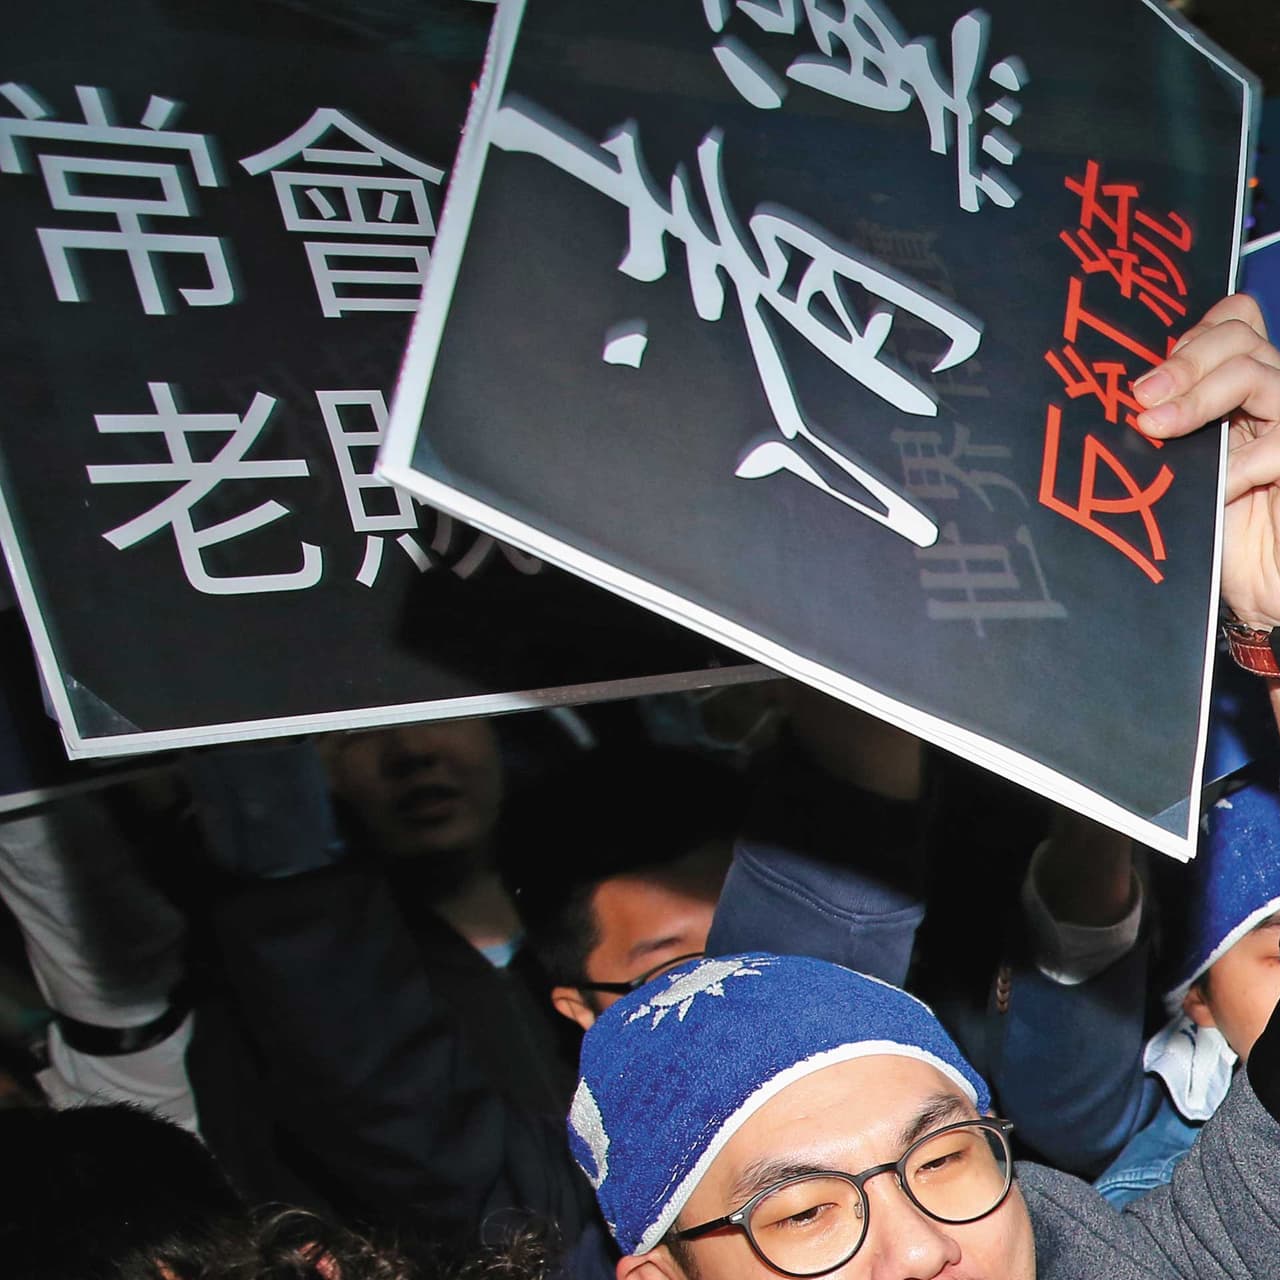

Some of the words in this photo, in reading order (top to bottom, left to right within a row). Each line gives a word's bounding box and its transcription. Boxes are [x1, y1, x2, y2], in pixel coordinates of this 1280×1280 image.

[0, 82, 446, 319] 常會
[1039, 160, 1193, 585] 反紅統
